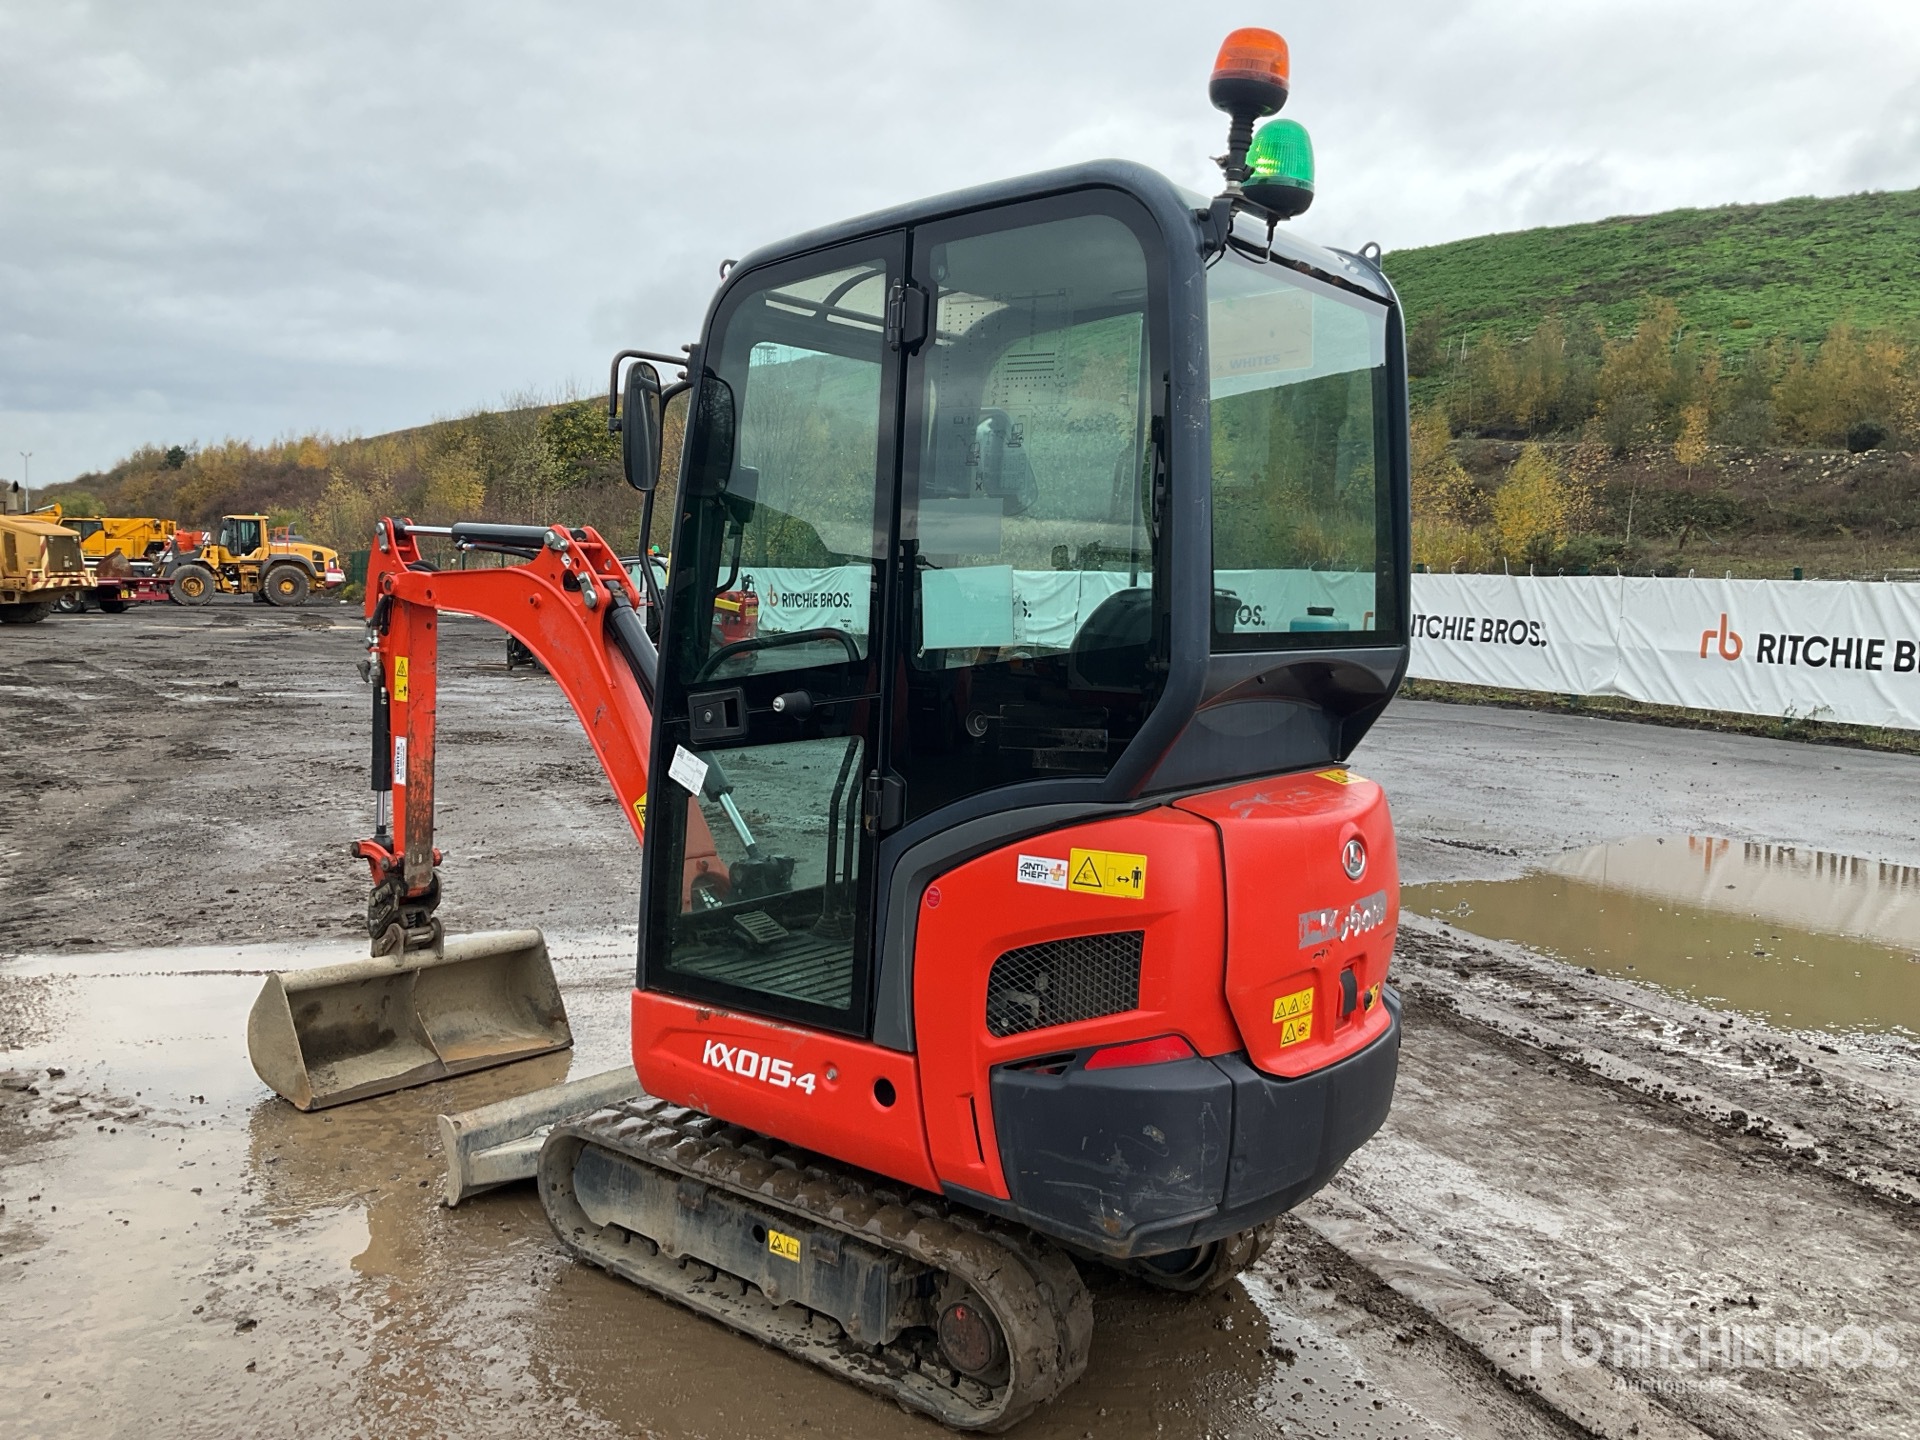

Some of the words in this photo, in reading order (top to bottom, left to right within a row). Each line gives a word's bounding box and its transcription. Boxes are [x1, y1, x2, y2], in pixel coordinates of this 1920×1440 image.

[1230, 354, 1281, 369] WHITES
[781, 592, 818, 608] RITCHIE
[820, 592, 852, 608] BROS.
[1237, 604, 1266, 626] OS.
[1410, 613, 1476, 642] ITCHIE
[1479, 618, 1547, 647] BROS.
[1700, 613, 1744, 661] rb
[1756, 633, 1886, 671] RITCHIE
[1893, 640, 1920, 673] B
[1020, 868, 1050, 881] THEFT
